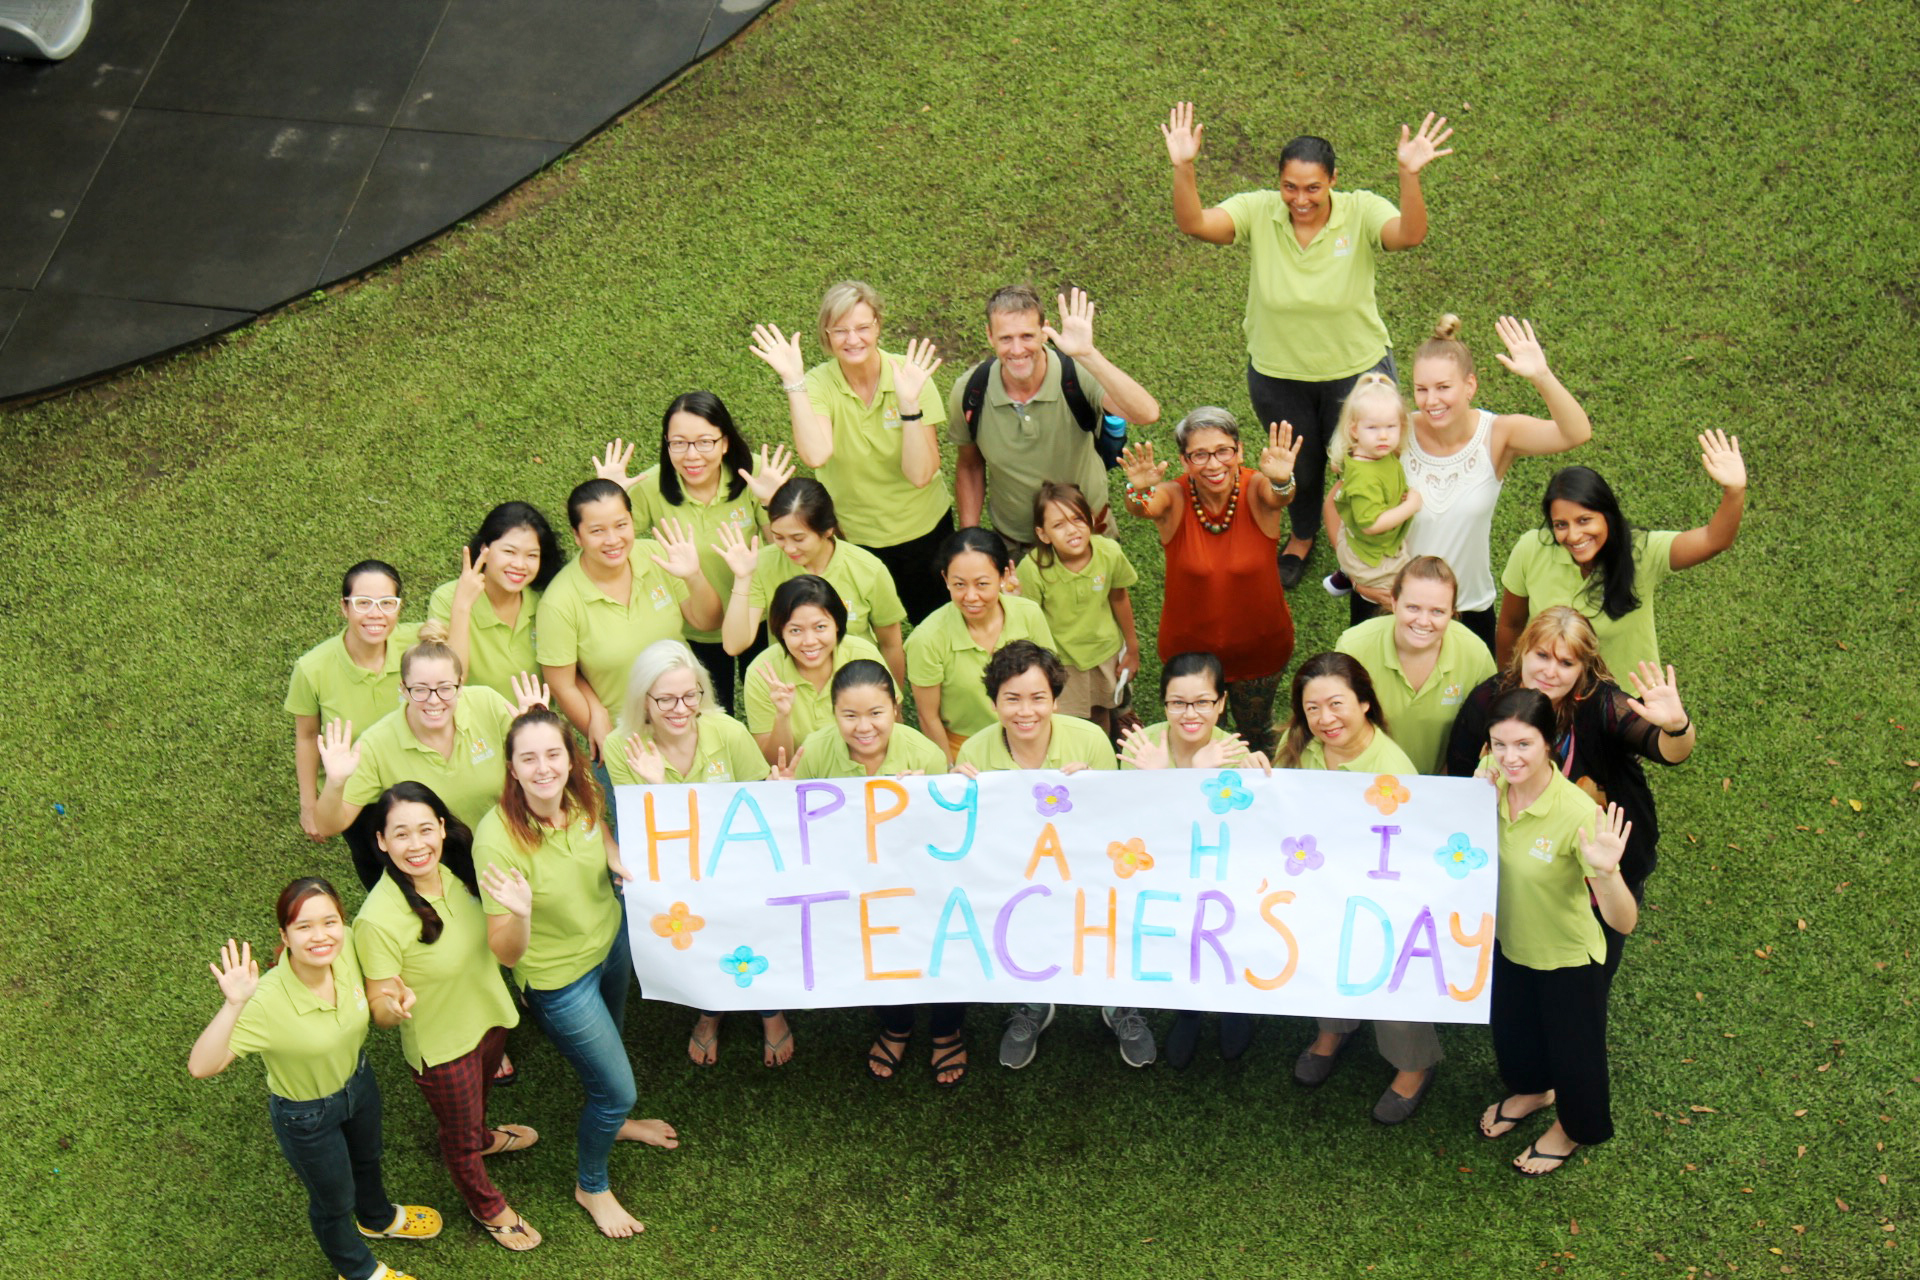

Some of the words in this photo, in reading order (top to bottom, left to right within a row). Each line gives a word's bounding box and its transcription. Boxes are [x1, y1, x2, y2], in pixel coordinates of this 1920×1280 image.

[643, 779, 979, 882] HAPPY
[765, 878, 1299, 991] TEACHER'S
[1336, 894, 1495, 1003] DAY
